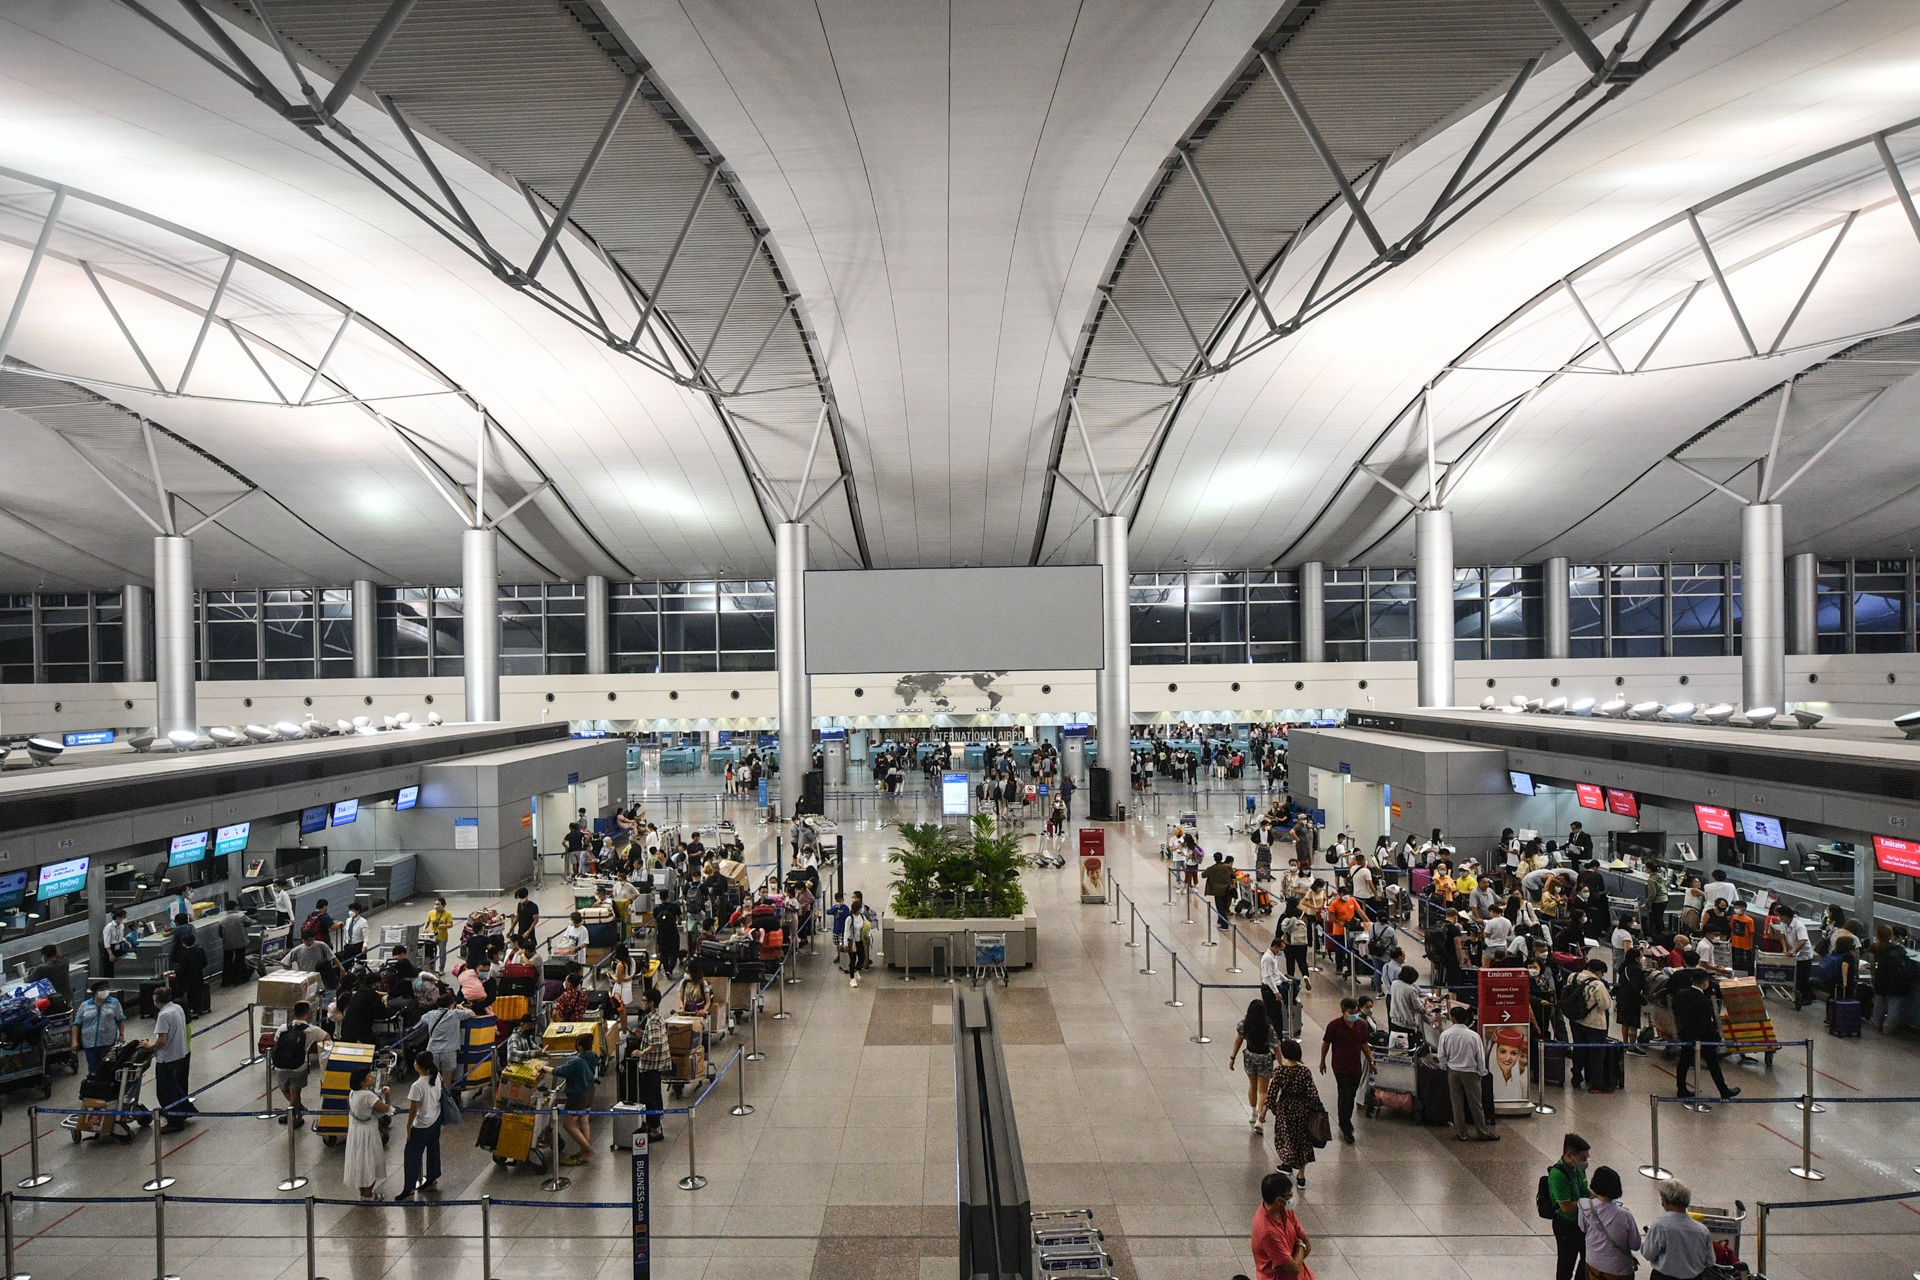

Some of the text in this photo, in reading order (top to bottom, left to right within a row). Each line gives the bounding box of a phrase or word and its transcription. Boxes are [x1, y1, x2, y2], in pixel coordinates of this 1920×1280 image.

[930, 731, 996, 742] INTERNATIONAL
[1891, 817, 1905, 827] G-5
[61, 840, 72, 848] F-5
[1880, 838, 1907, 850] Emirates
[636, 1160, 645, 1222] BUSINESS CLASS
